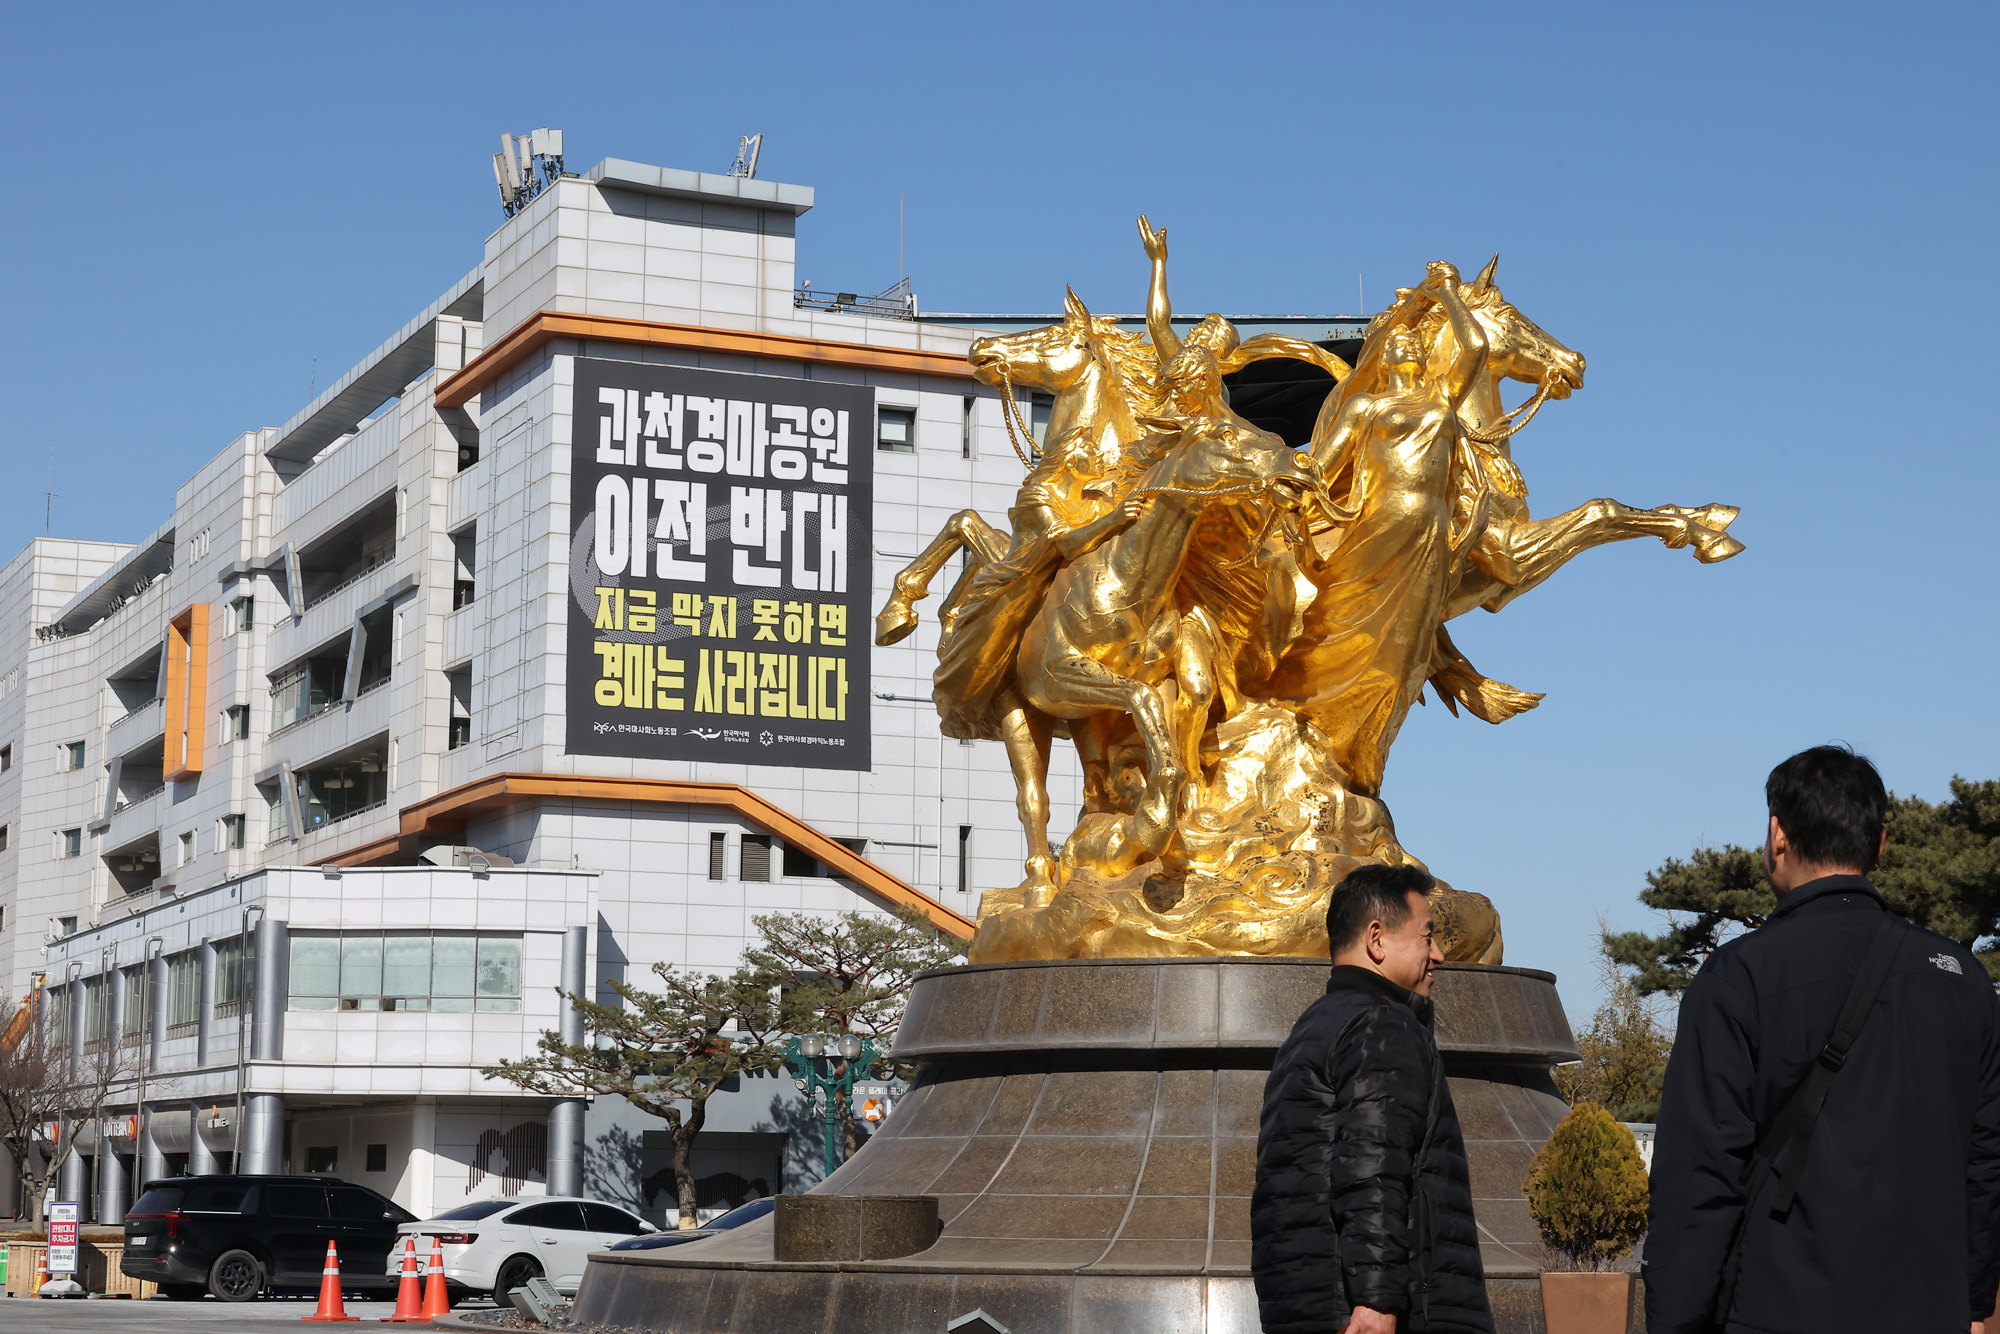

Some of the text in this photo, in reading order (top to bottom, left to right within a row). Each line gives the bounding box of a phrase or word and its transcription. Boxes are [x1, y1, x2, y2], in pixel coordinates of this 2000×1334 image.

[594, 385, 849, 478] 과천경마공원
[593, 474, 848, 593] 이전 반대
[593, 585, 848, 648] 지금 막지 못하면
[593, 640, 850, 723] 경마는 사라집니다
[618, 724, 678, 737] 한국마사회노동조합
[51, 1234, 75, 1243] 주차금지
